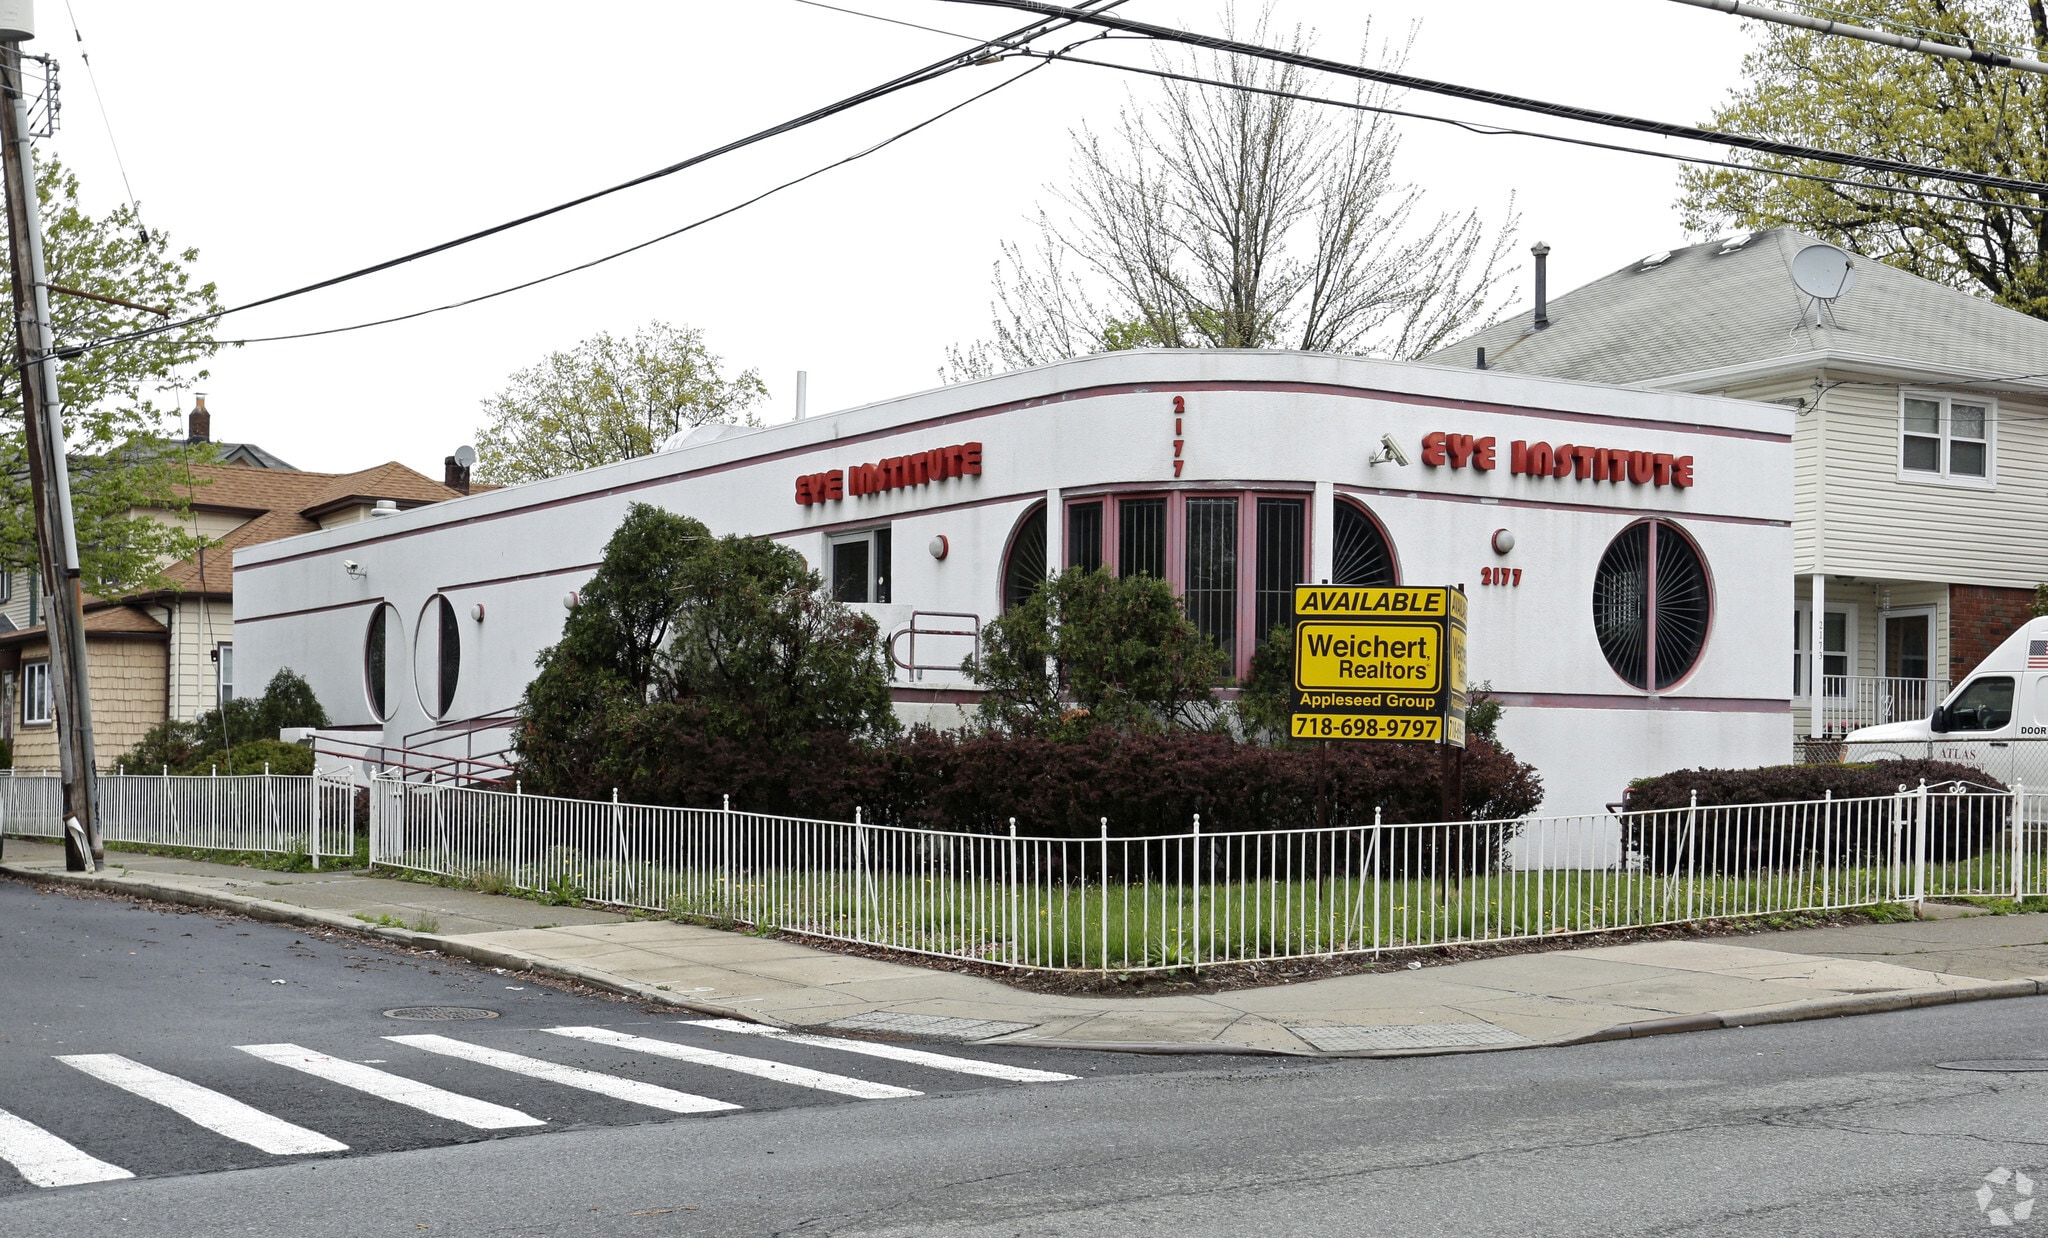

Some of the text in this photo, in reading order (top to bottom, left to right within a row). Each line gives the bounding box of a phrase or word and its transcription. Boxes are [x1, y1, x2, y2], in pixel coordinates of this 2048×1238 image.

[1173, 395, 1185, 478] 2177
[1421, 431, 1694, 488] EYE INSTITUTE
[795, 441, 982, 505] EYE INSTITUTE
[1480, 566, 1523, 587] 2177
[1300, 591, 1441, 612] AVAILABLE
[1307, 633, 1431, 661] Weichert,
[1299, 692, 1382, 709] Appleseed
[1386, 693, 1436, 711] Group
[1295, 717, 1438, 738] 718-698-9797
[2021, 726, 2047, 735] DOOR
[1940, 748, 1977, 760] ATLAS
